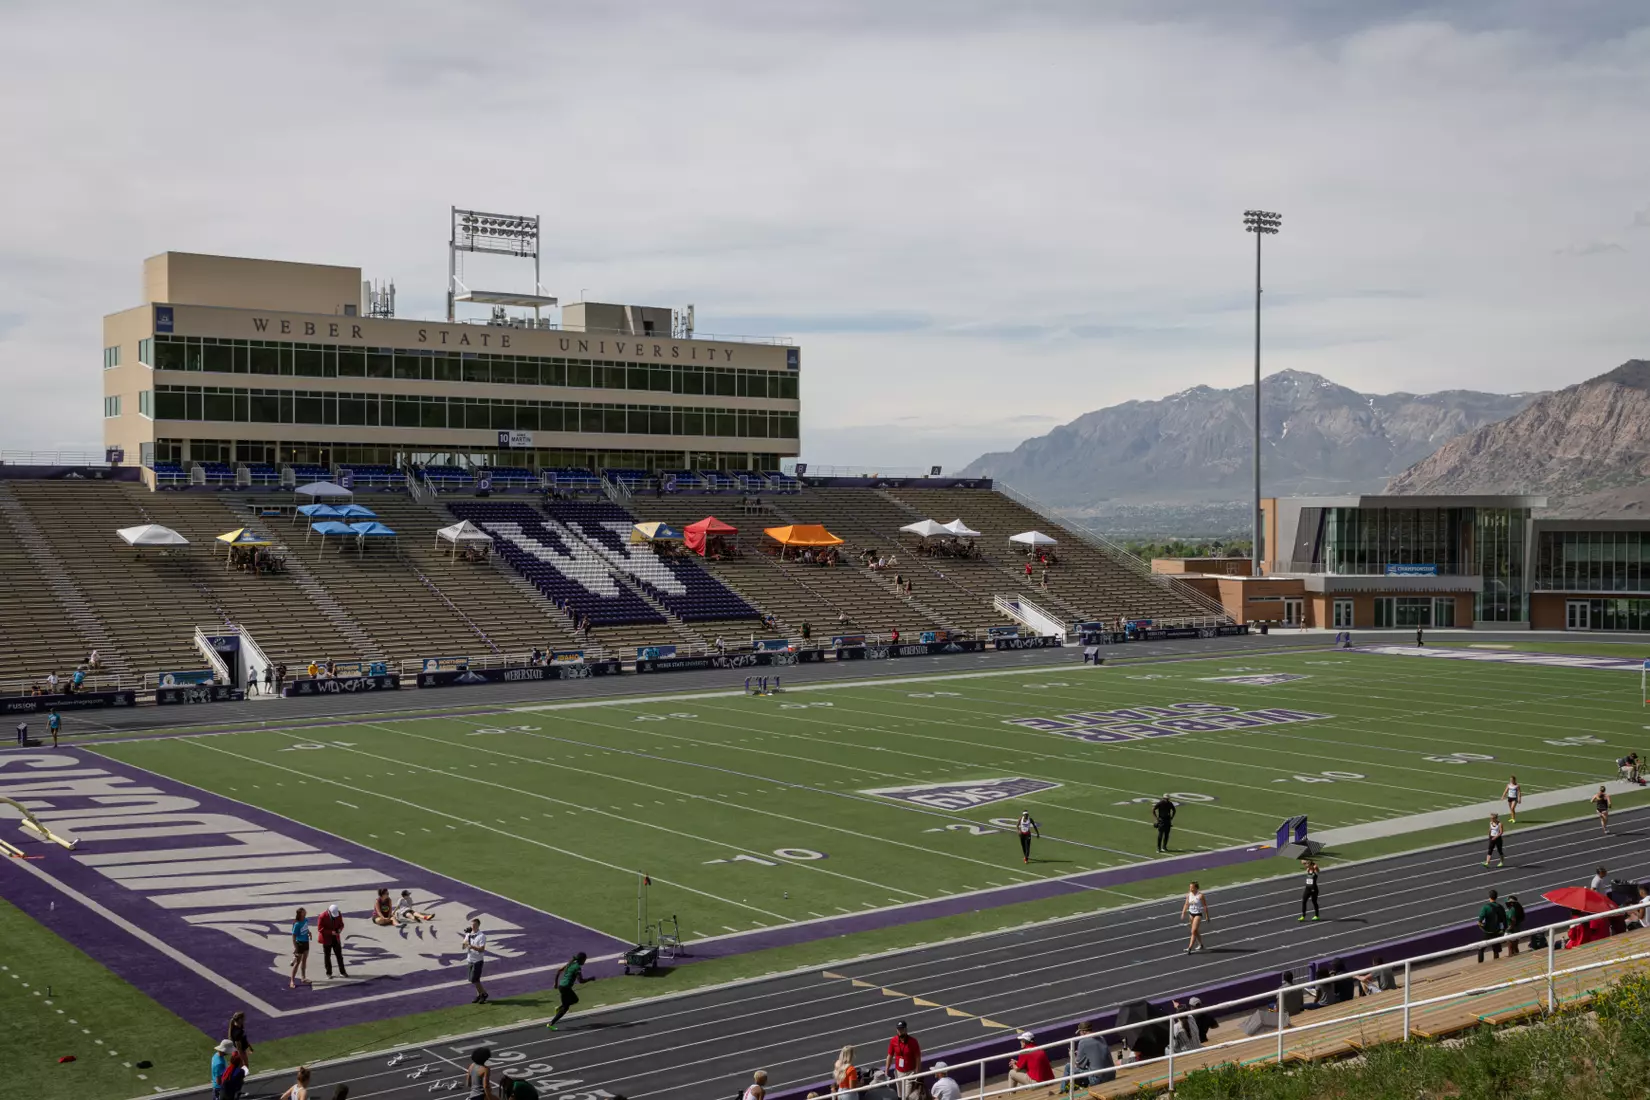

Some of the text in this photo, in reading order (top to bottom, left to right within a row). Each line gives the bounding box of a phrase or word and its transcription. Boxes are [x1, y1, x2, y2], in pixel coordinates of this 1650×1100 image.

[252, 317, 734, 362] WEBER STATE UNIVERSITY
[499, 433, 509, 443] 10
[342, 477, 349, 488] E
[481, 479, 489, 490] D
[667, 480, 674, 491] C
[557, 653, 580, 661] IDAHO
[899, 645, 929, 656] WEBER STATE
[504, 669, 544, 681] WEBER STATE
[8, 702, 37, 710] FUSION
[1000, 702, 1238, 730] STATE
[1047, 707, 1334, 742] WEBER
[1421, 752, 1493, 765] 50
[1292, 770, 1366, 783] 40
[732, 848, 824, 867] 10
[448, 1040, 499, 1054] 1
[484, 1051, 528, 1067] 2
[502, 1063, 554, 1079] 3
[533, 1079, 584, 1094] 4
